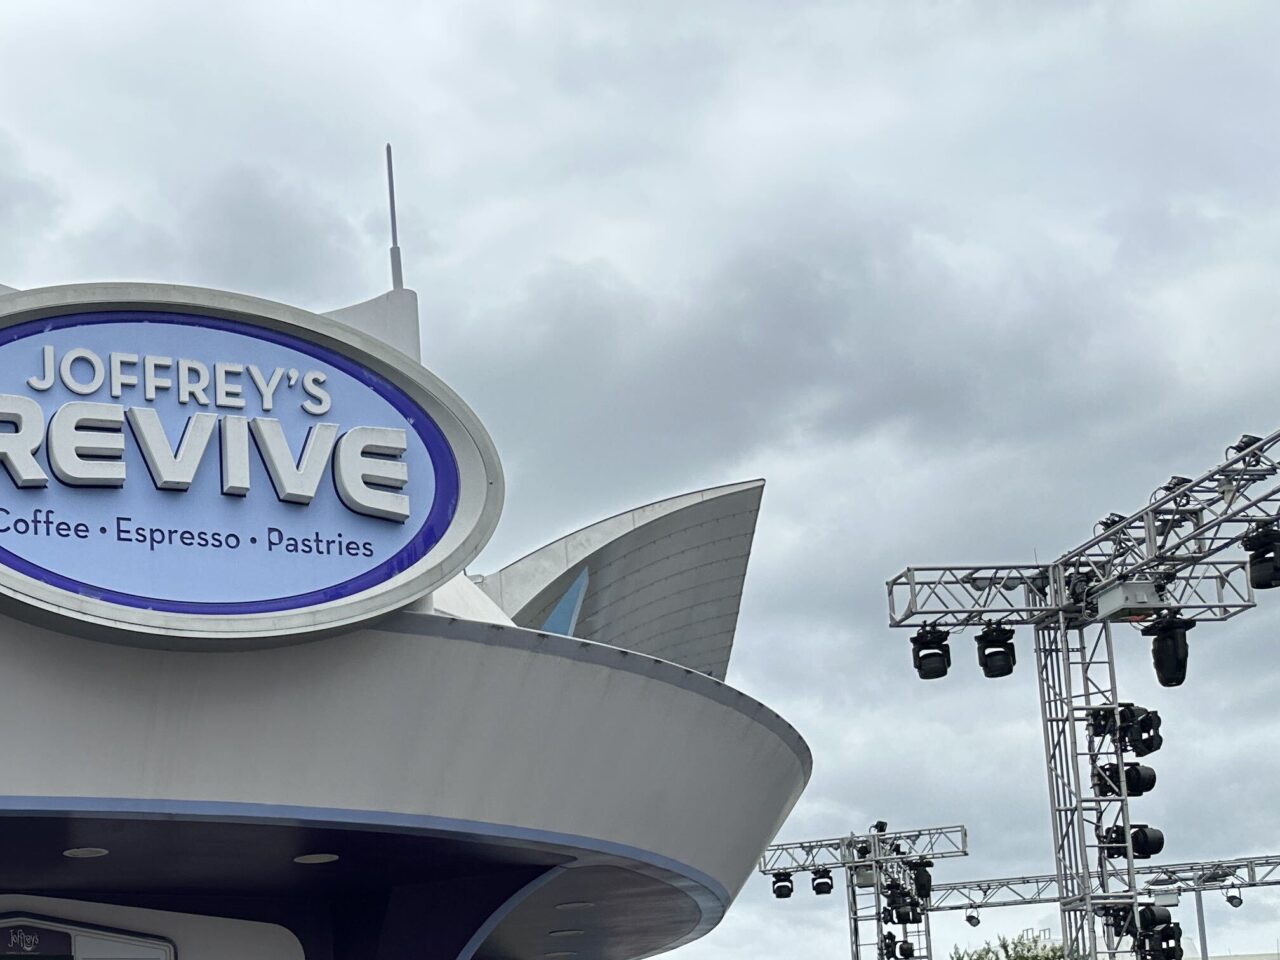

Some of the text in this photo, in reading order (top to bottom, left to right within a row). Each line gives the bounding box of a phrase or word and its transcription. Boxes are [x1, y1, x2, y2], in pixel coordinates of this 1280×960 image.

[27, 344, 332, 415] JOFFREY'S
[115, 517, 241, 551] Espresso
[267, 526, 375, 558] Pastries
